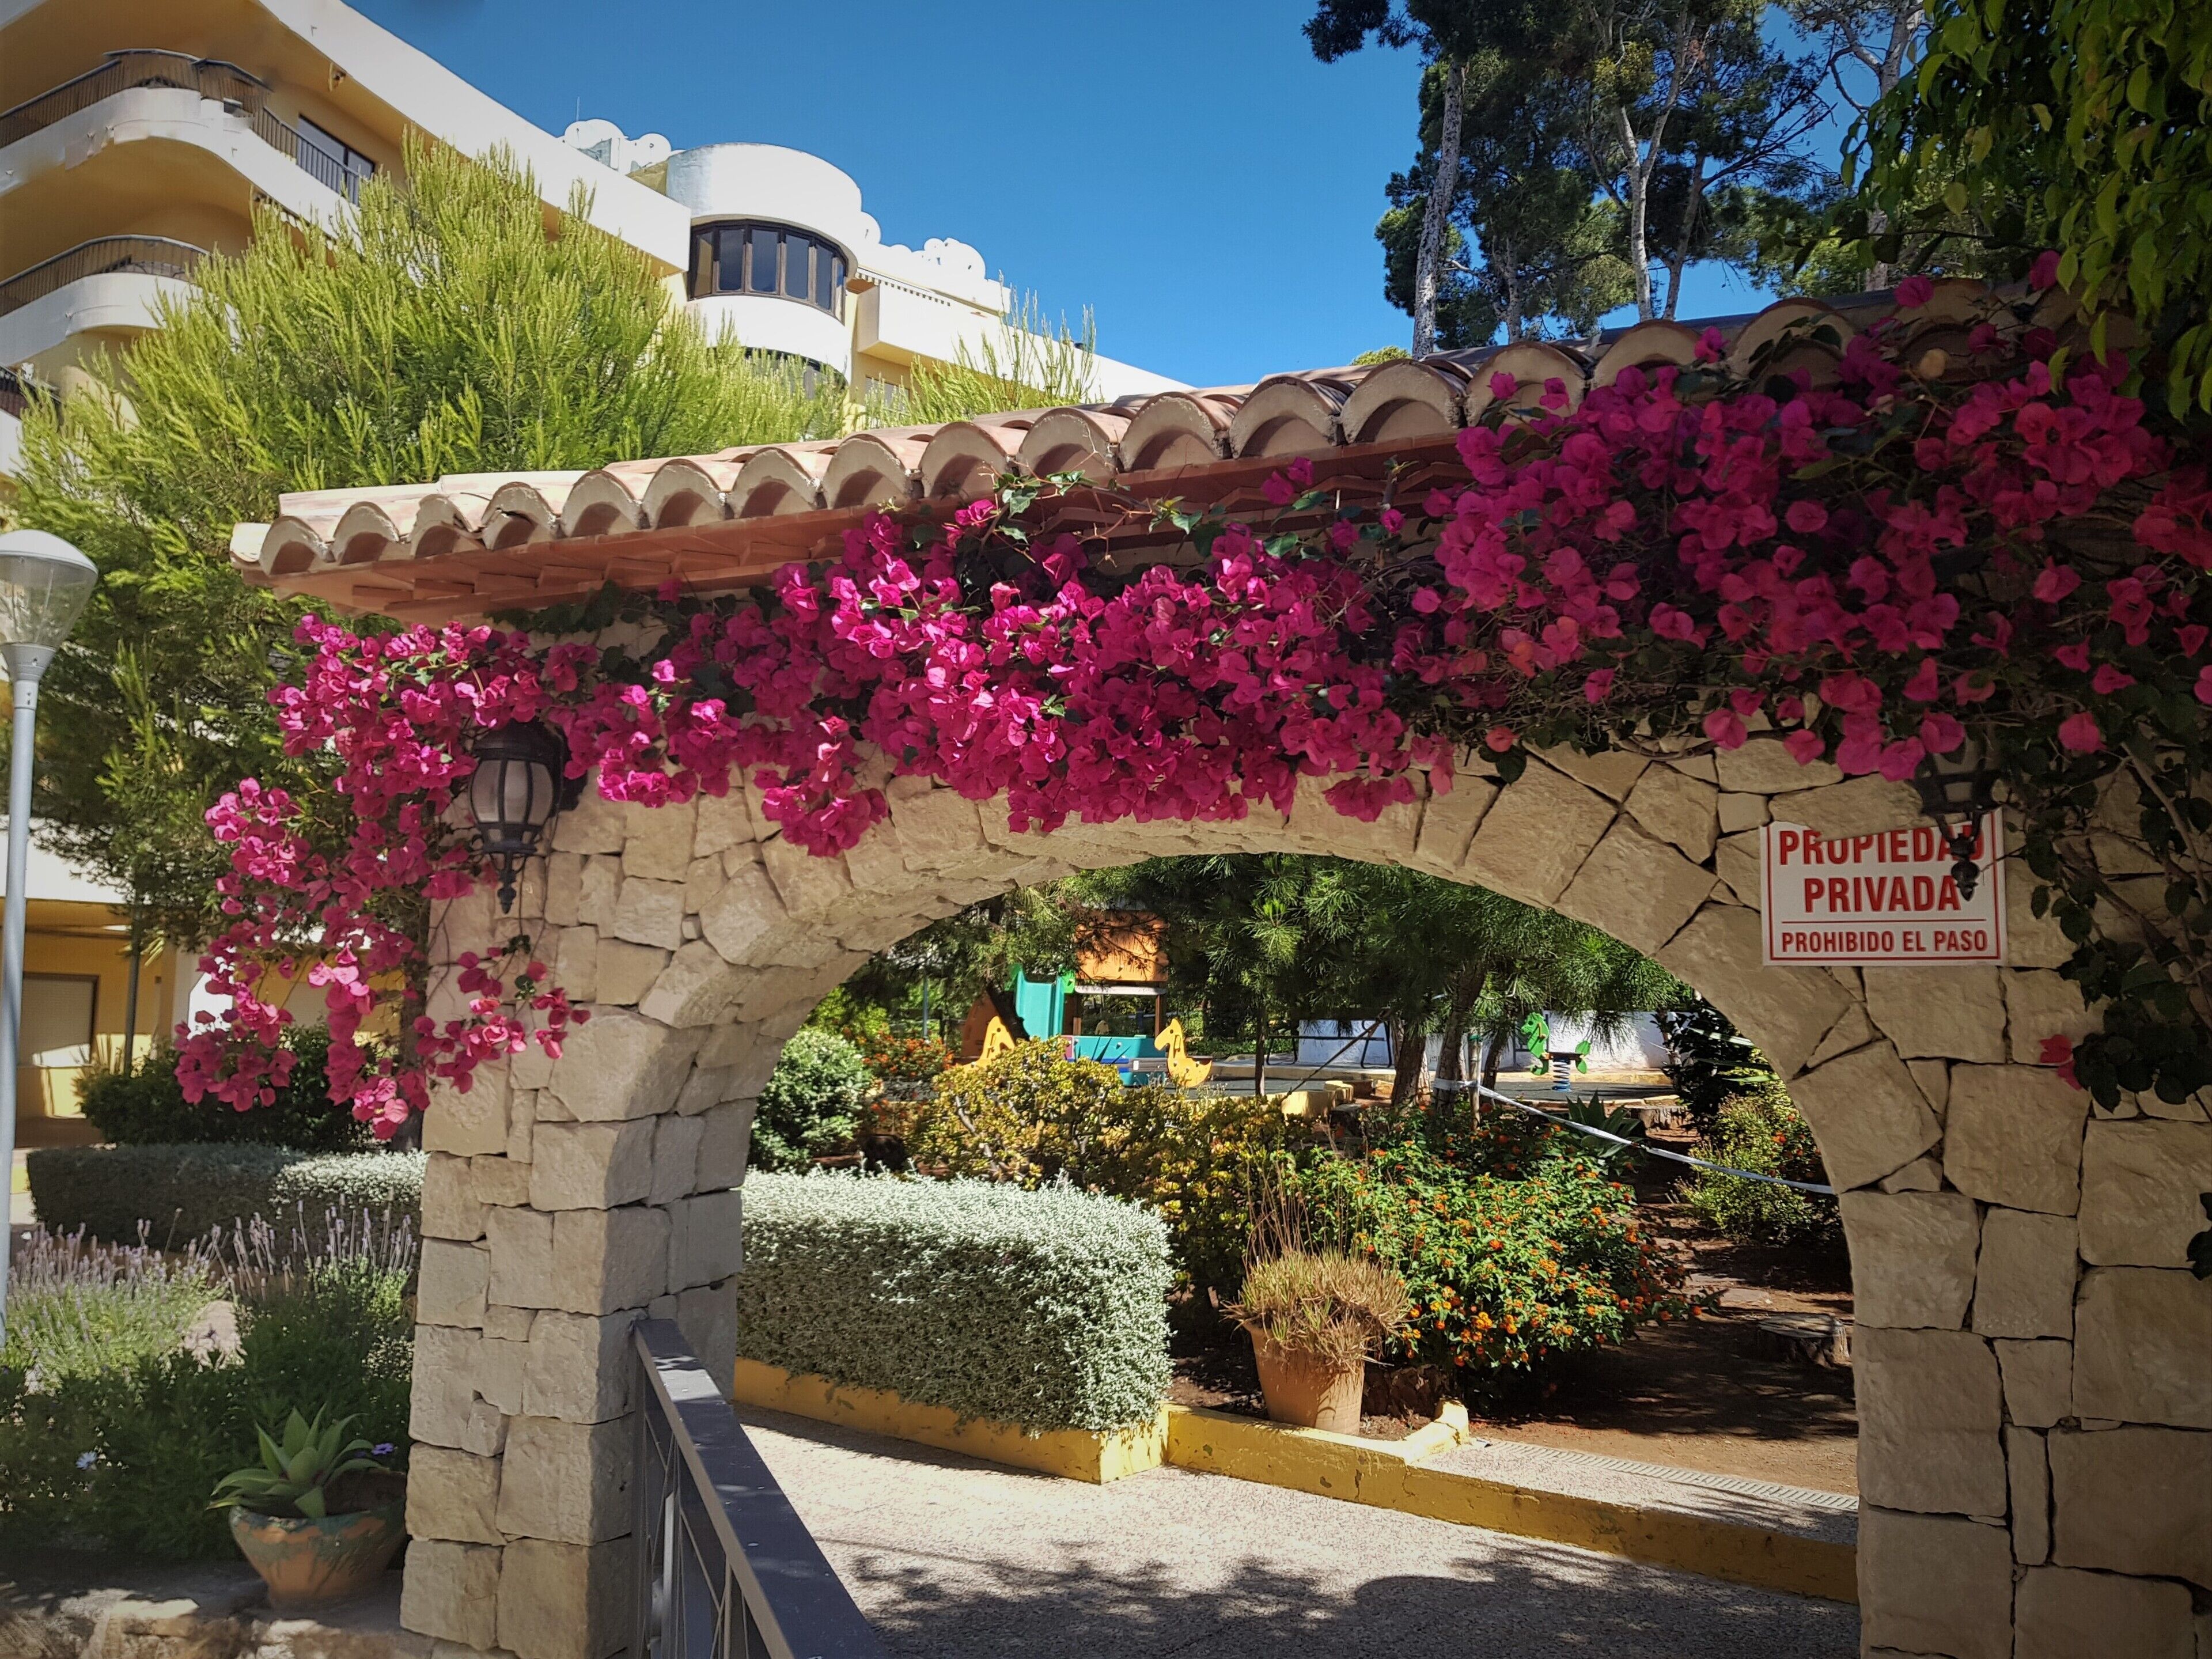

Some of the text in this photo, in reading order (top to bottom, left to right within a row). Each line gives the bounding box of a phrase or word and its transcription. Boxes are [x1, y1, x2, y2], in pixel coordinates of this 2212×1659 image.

[1804, 875, 1961, 913] PRIVADA
[1782, 929, 1988, 952] PROHIBIDO EL PASO
